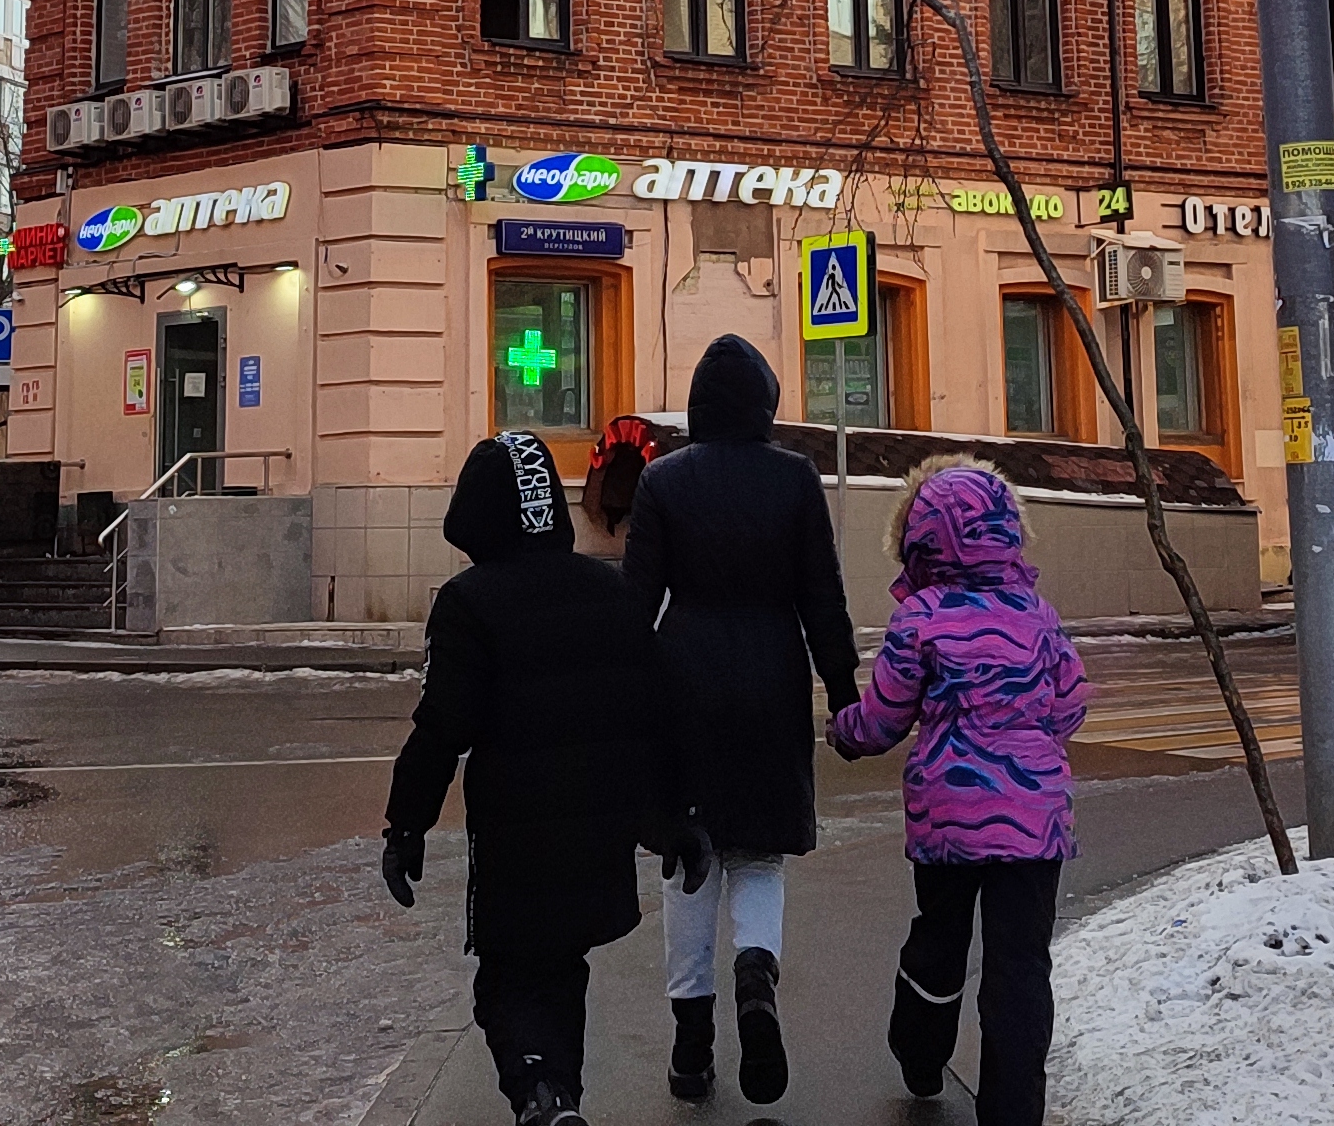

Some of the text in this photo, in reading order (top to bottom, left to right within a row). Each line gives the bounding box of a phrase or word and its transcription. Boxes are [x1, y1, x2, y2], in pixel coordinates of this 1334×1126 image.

[520, 158, 842, 209] неофарм аптека
[79, 182, 290, 240] неофарм аптека
[951, 187, 1129, 220] авокдо 24
[1184, 196, 1271, 236] Отел
[14, 224, 57, 247] МИНИ
[536, 228, 606, 242] КРУТИЦКИЙ
[9, 242, 64, 270] МАРКЕТ
[520, 488, 552, 502] 17/52
